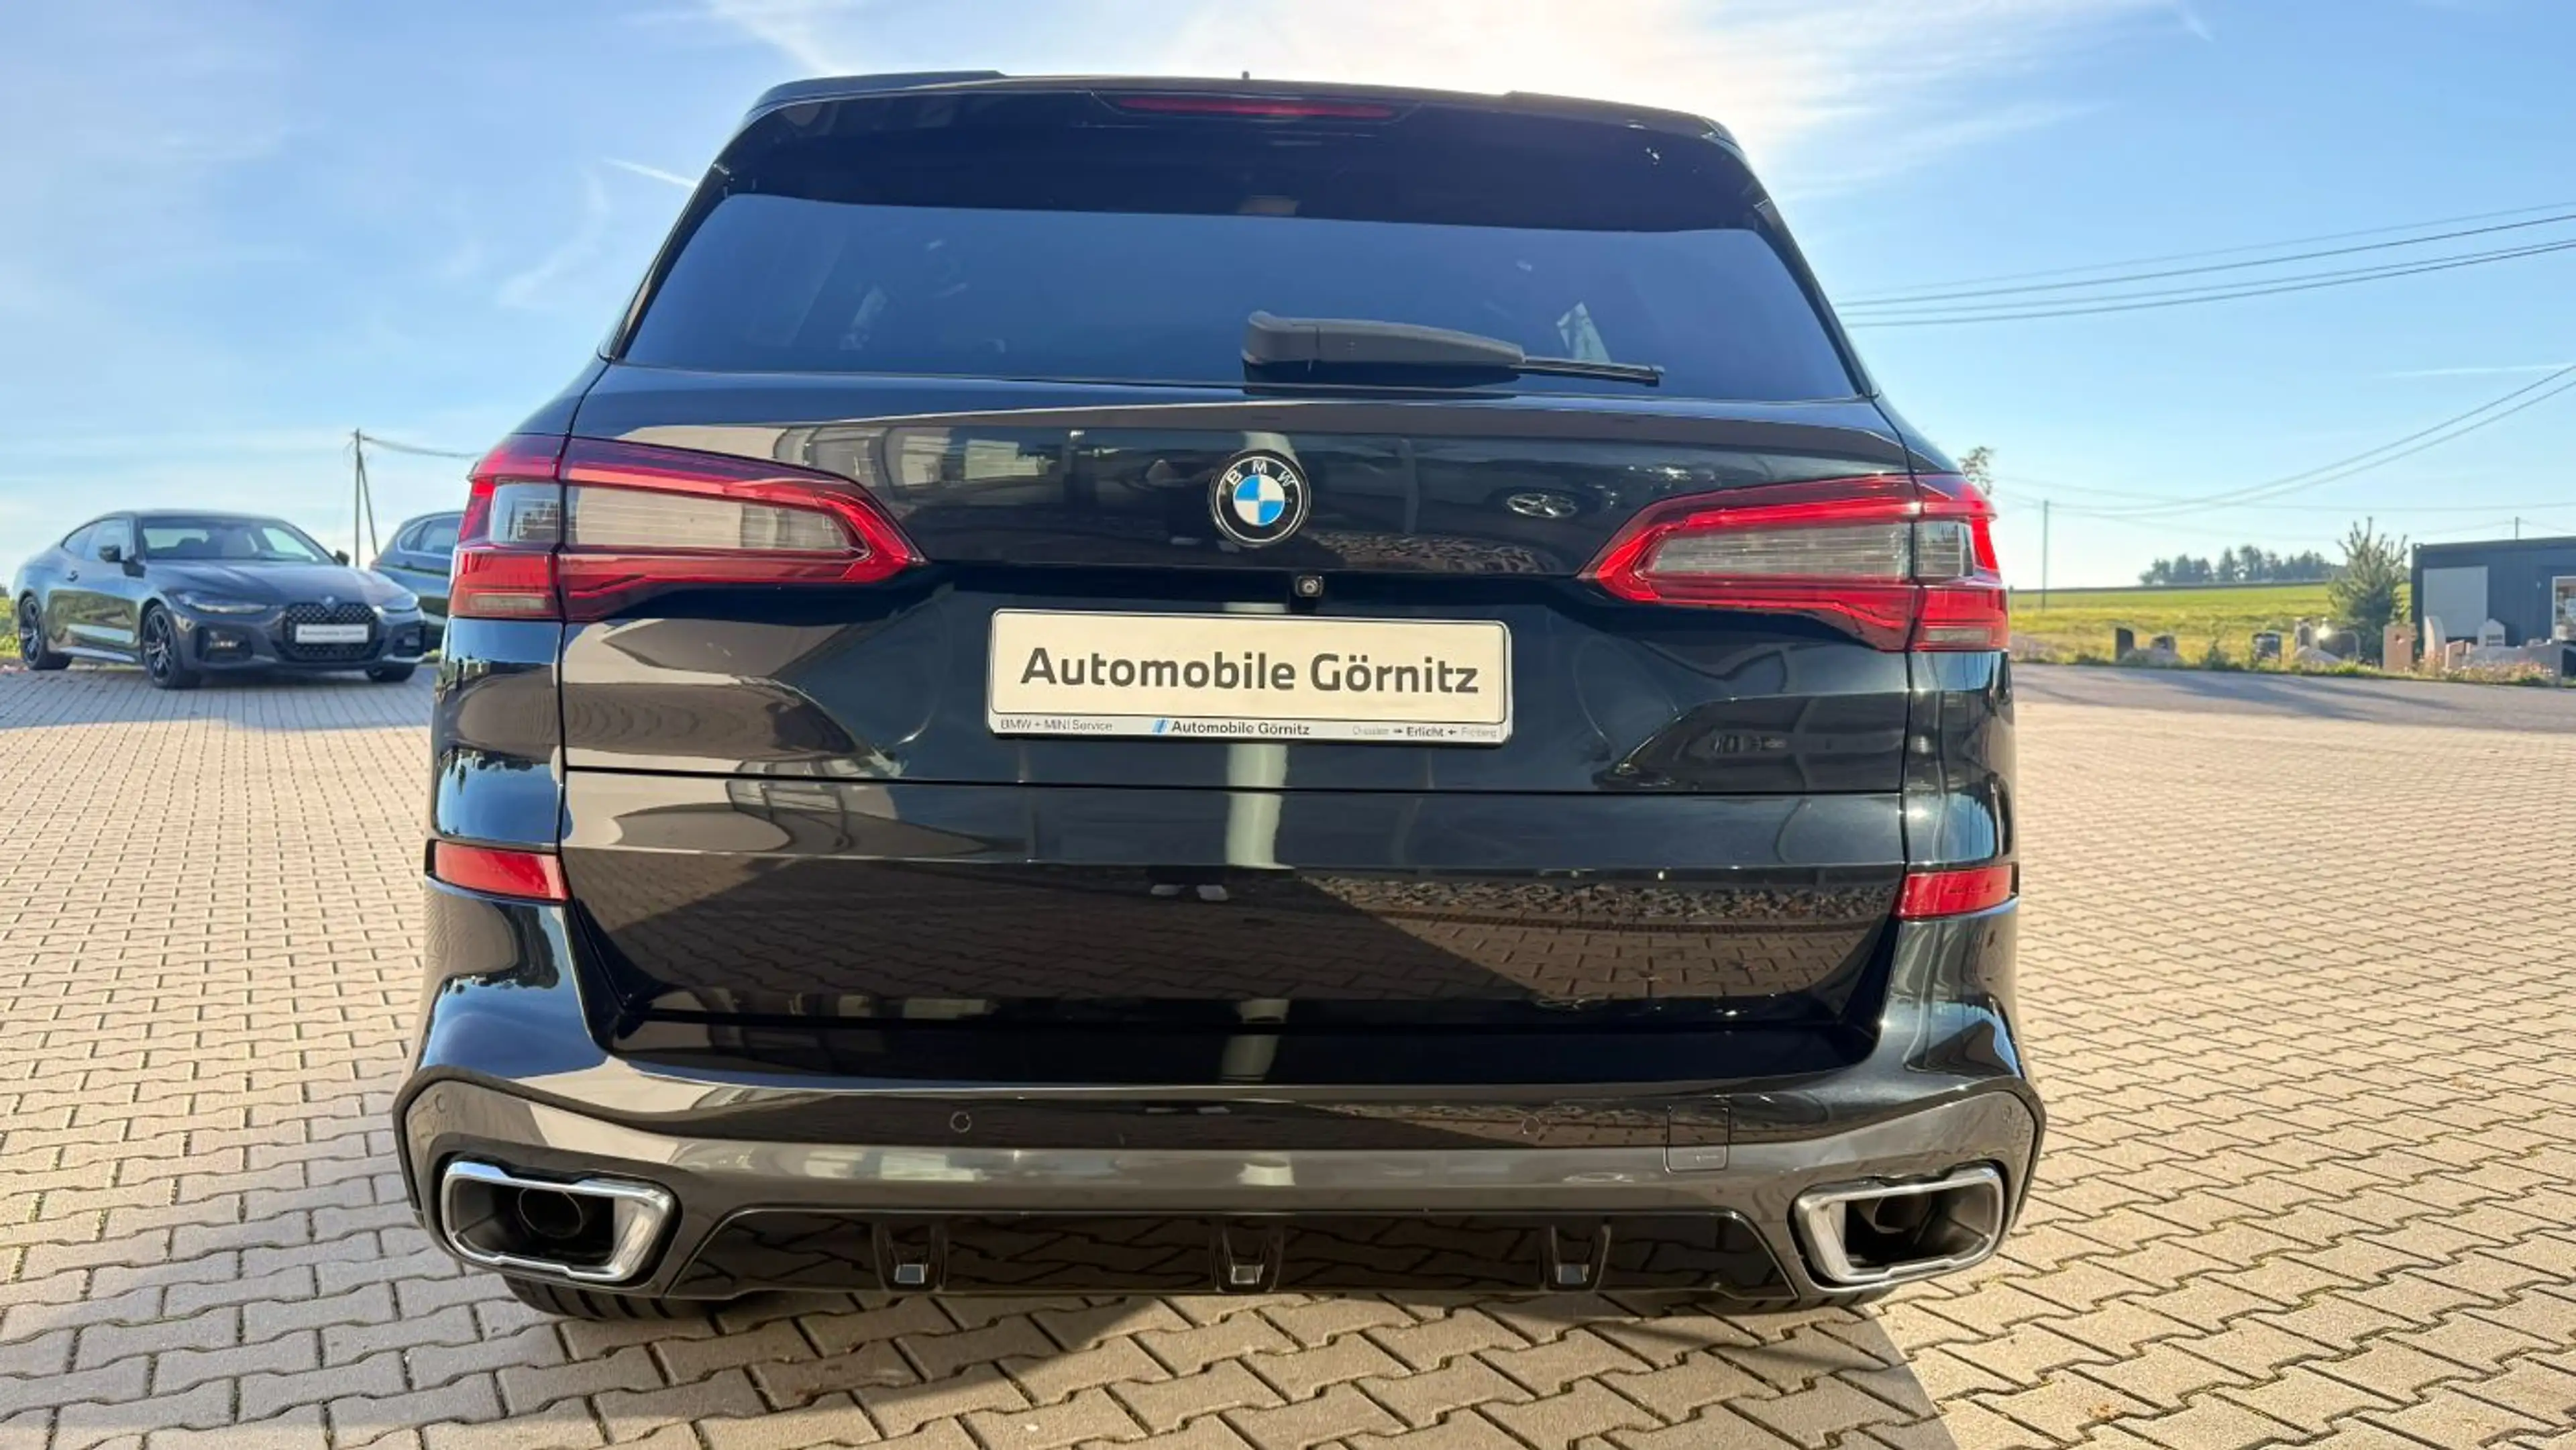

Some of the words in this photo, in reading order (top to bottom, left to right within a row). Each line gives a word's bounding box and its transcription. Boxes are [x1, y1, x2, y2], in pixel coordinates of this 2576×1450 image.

[1226, 459, 1295, 486] BMW
[1020, 648, 1296, 690] Automobile
[1311, 654, 1479, 693] Görnitz
[1000, 719, 1031, 730] BMW
[1073, 719, 1113, 731] Service
[1171, 720, 1254, 734] Automobile
[1258, 723, 1310, 735] Görnitz
